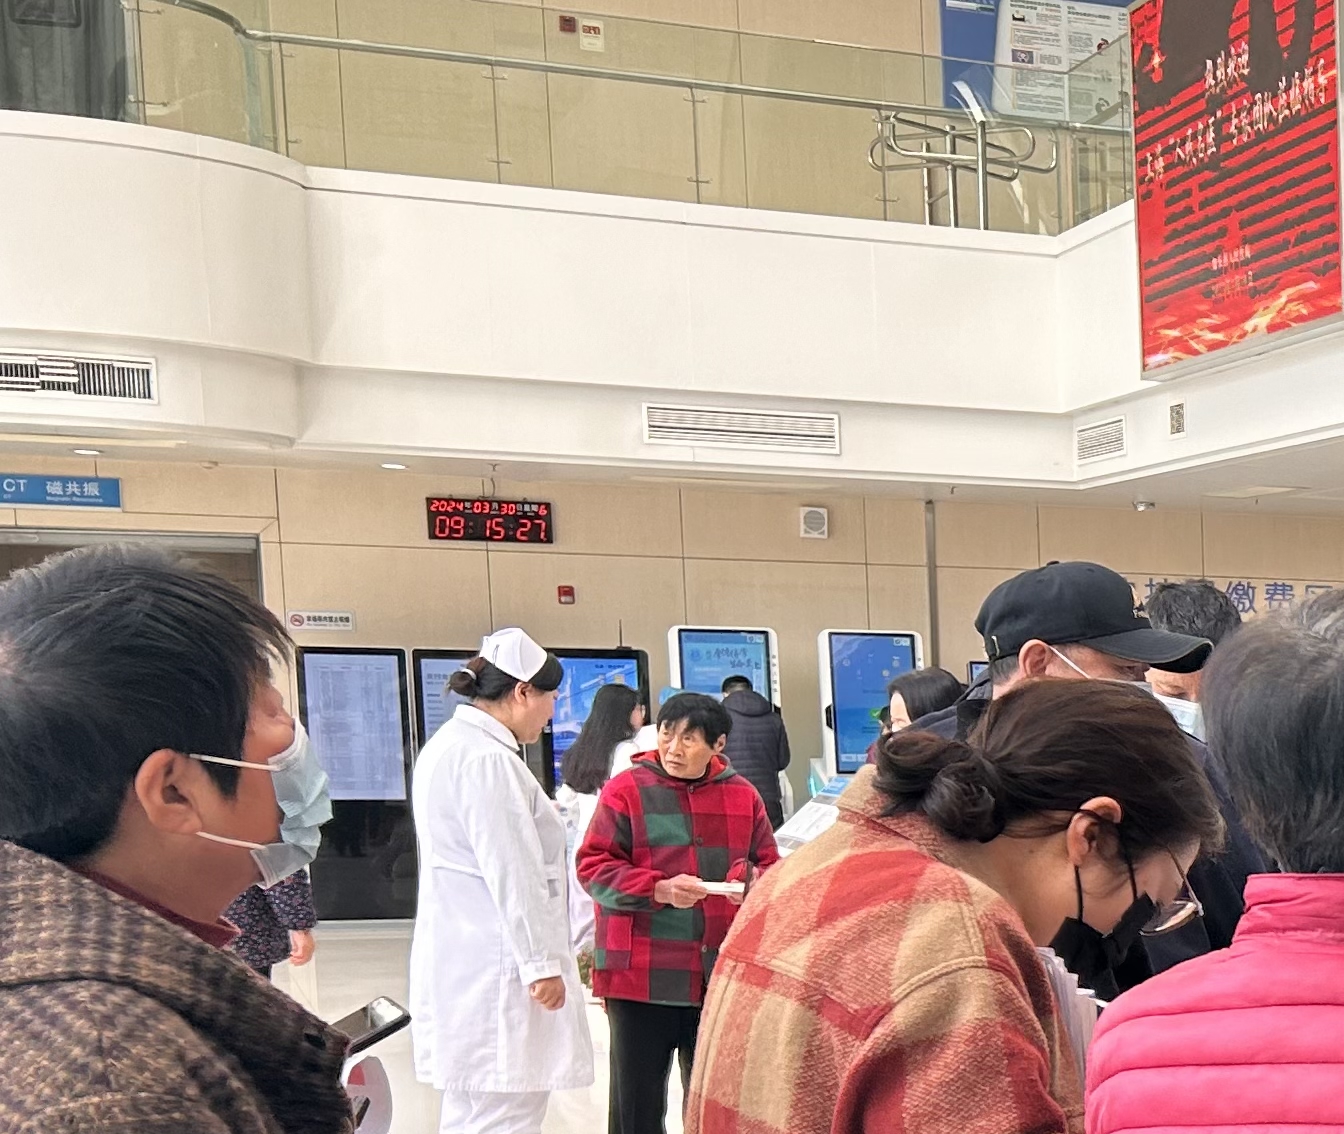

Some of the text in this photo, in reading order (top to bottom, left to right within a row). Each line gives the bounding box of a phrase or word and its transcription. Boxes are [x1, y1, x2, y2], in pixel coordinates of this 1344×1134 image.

[2, 478, 27, 492] CT
[46, 481, 100, 496] 磁共振
